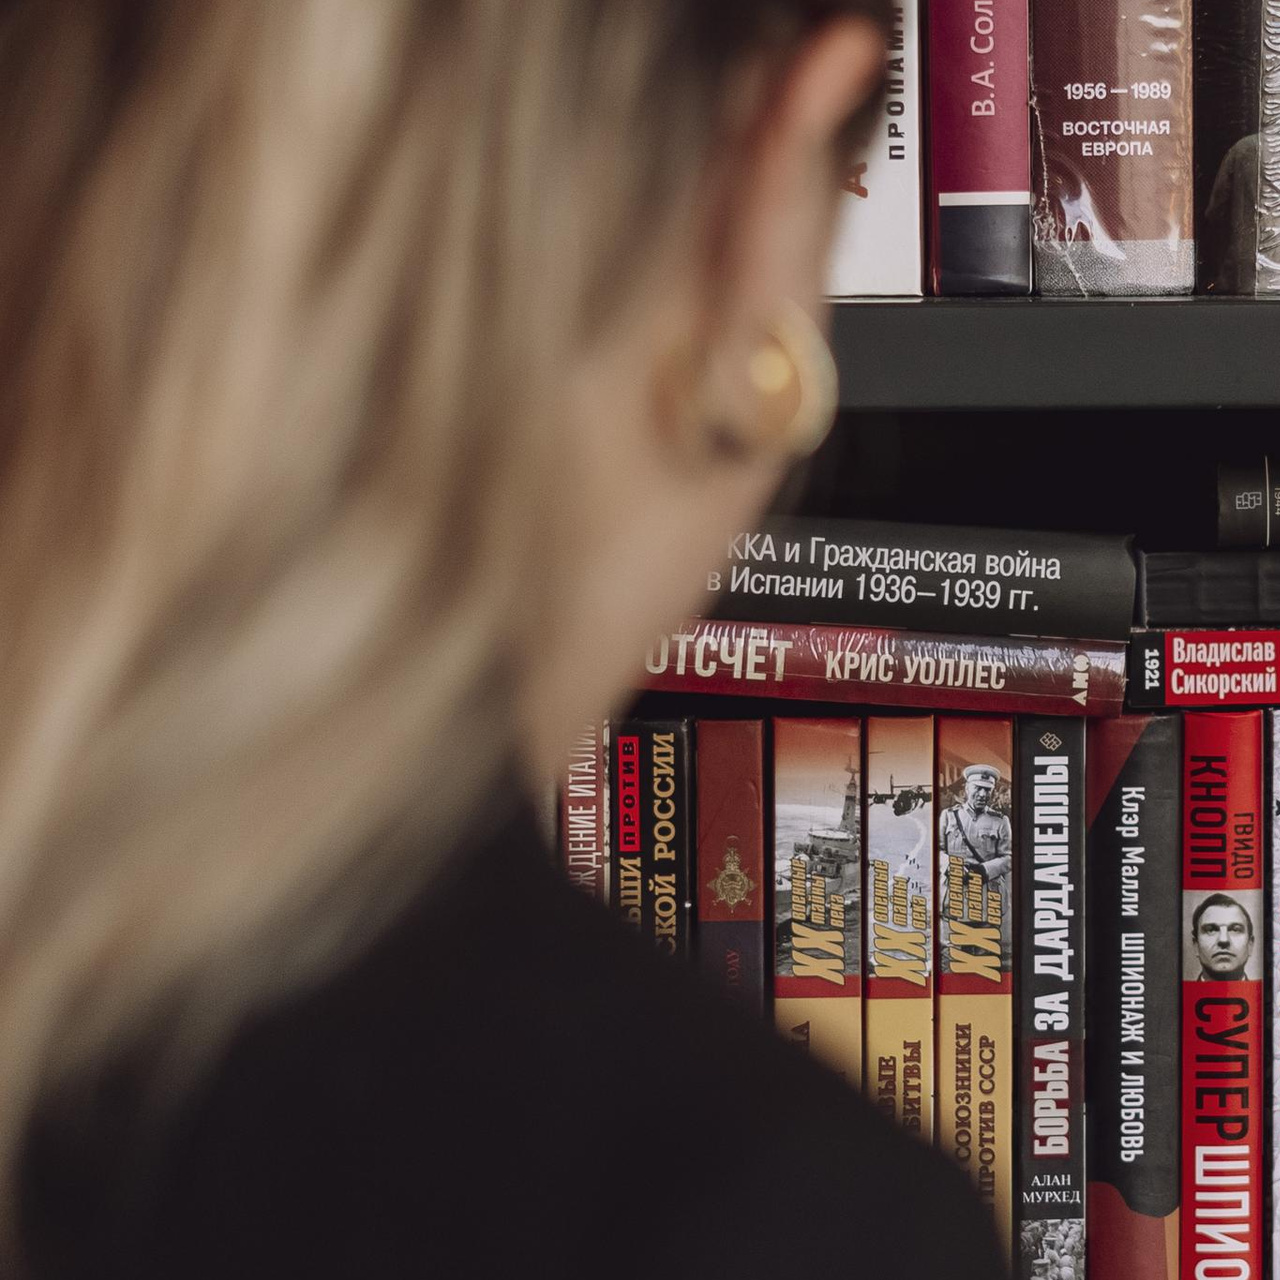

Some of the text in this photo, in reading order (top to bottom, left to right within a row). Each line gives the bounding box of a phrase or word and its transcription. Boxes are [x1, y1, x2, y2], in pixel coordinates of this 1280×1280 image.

[1063, 121, 1169, 136] ВОСТОЧНАЯ
[1083, 141, 1153, 156] ЕВРОПА
[809, 536, 1062, 580] Гражданская война
[730, 566, 844, 599] Испании
[1172, 635, 1275, 664] Владислав
[1171, 668, 1276, 697] Сикорский
[1033, 755, 1075, 1156] БОРЬБА ЗА ДАРДАНЕЛЛЫ
[979, 1036, 995, 1094] СССР
[955, 1024, 972, 1163] СОЮЗНИКИ
[1032, 1175, 1072, 1187] АЛАН
[1023, 1191, 1081, 1204] МУРХЕД
